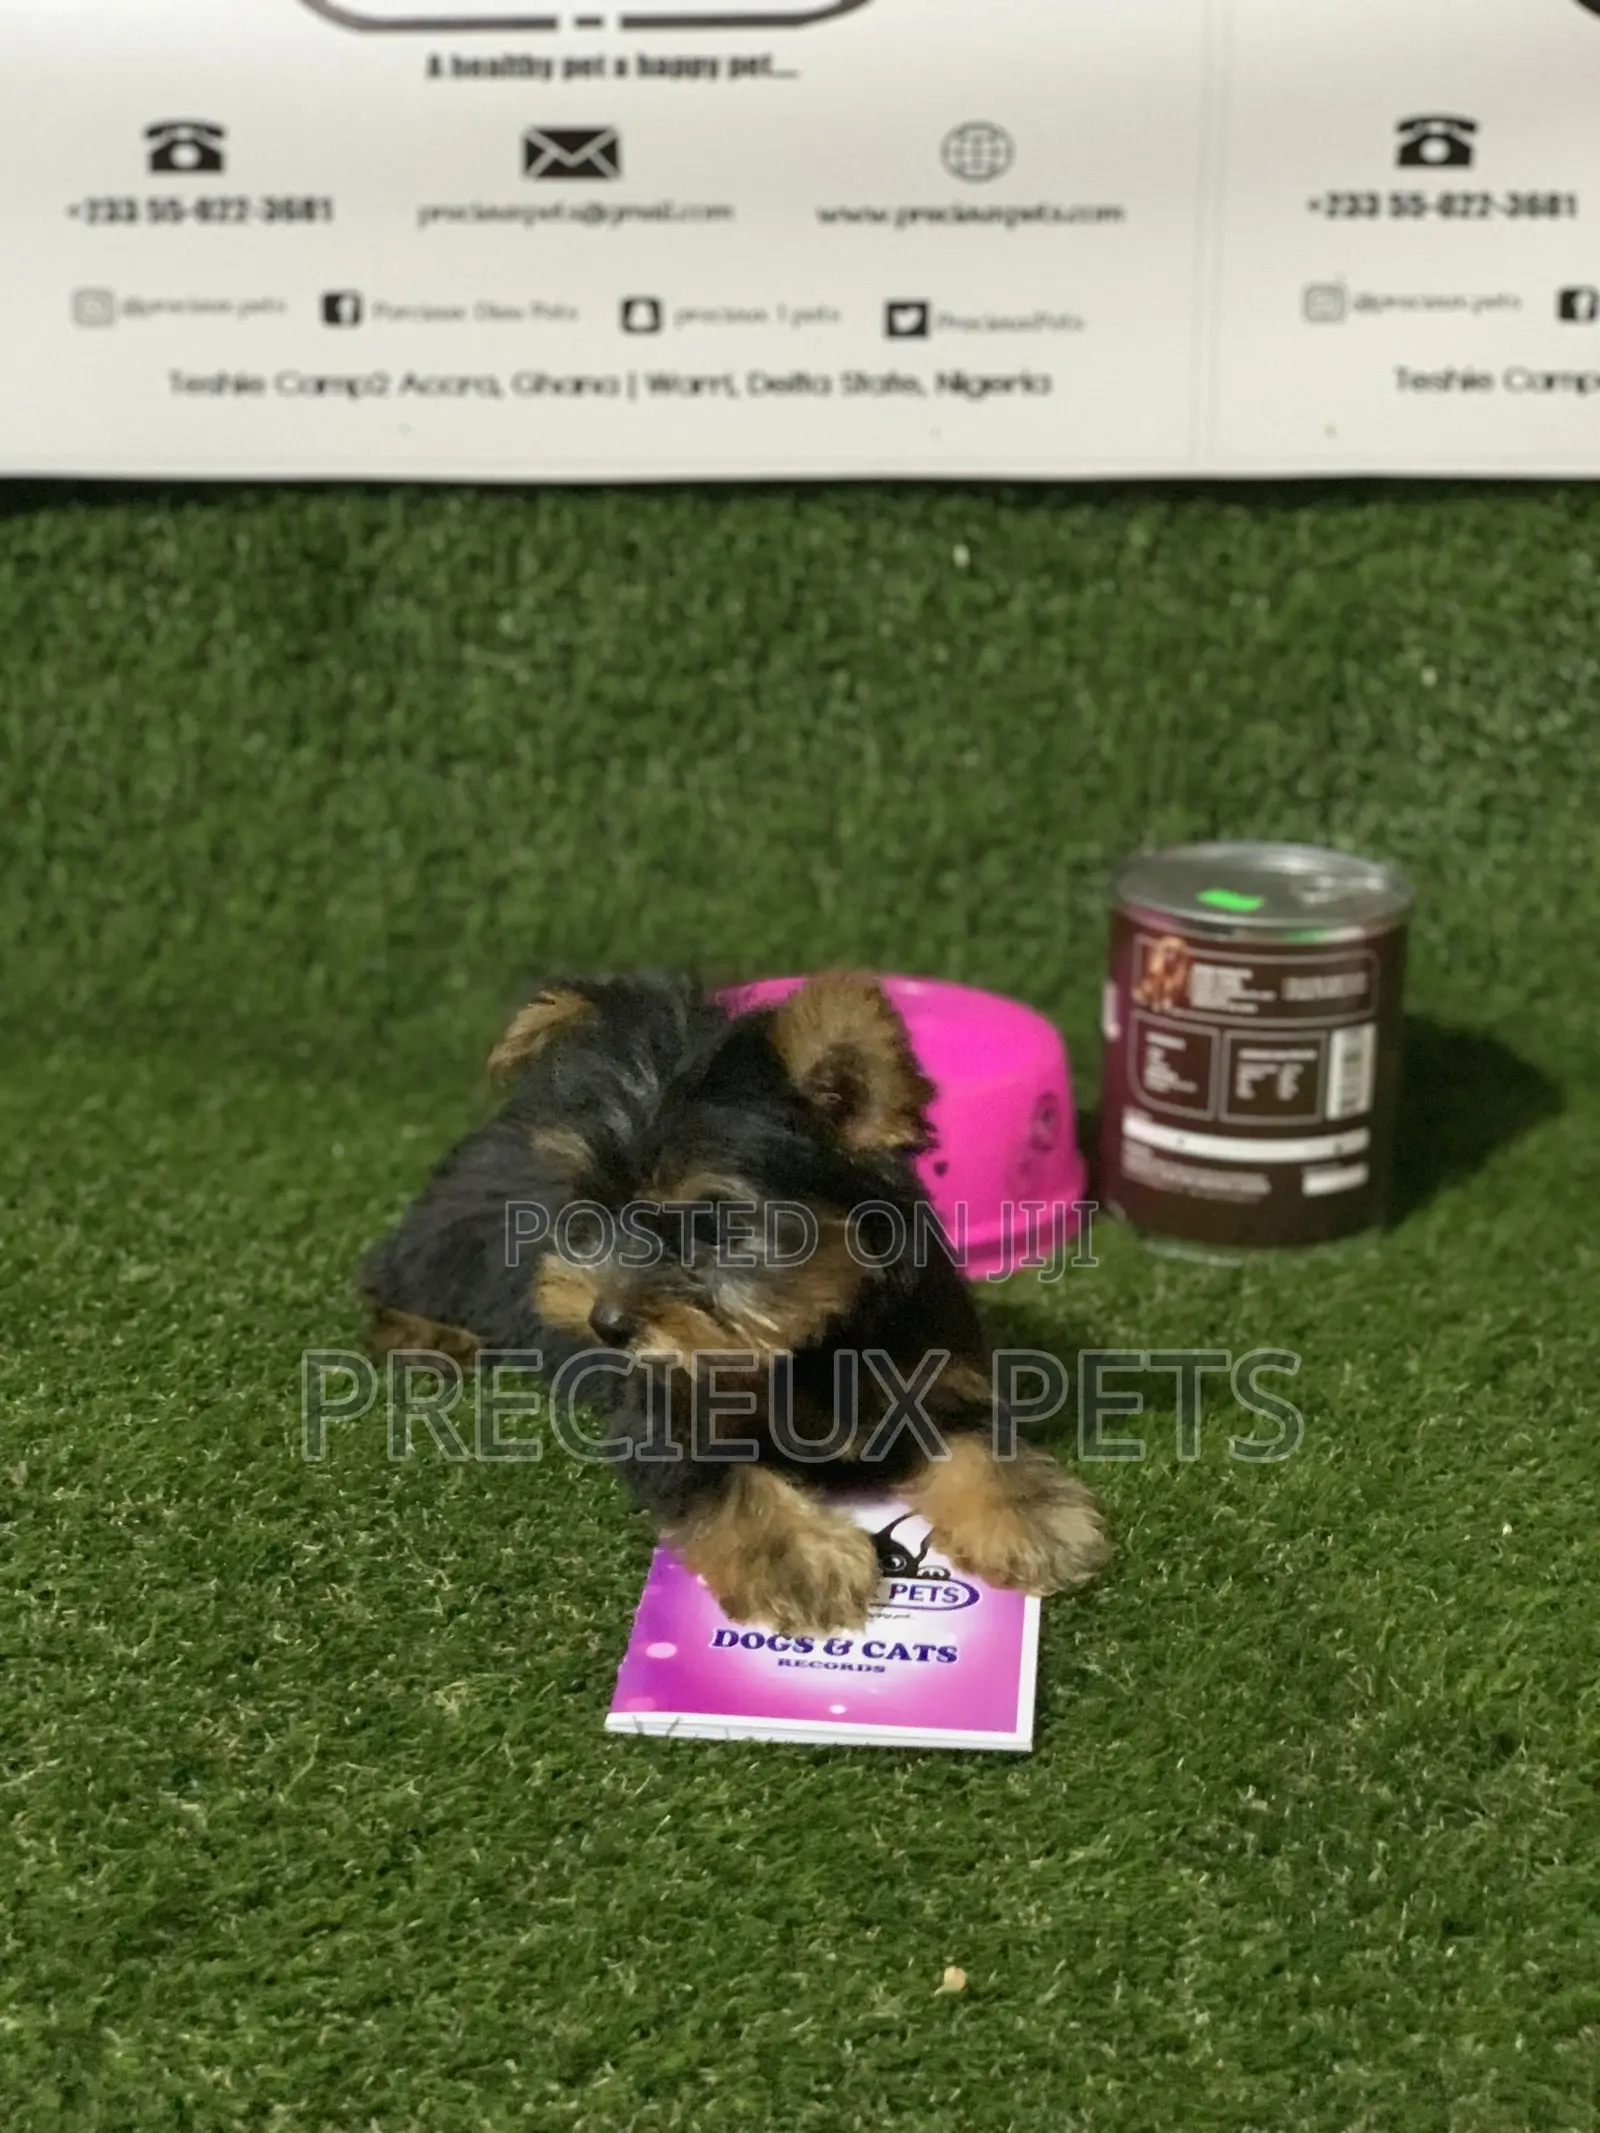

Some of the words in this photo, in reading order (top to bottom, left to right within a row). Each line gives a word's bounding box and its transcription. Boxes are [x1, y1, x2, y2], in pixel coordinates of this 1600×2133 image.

[427, 52, 442, 80] A
[451, 51, 553, 83] healthy
[561, 53, 605, 83] pet
[635, 52, 719, 83] happy
[64, 195, 138, 225] +233
[1307, 190, 1379, 220] +233
[168, 368, 267, 397] Teshie
[510, 368, 620, 399] Ghana
[643, 371, 741, 400] Warri,
[746, 370, 835, 399] Delta
[839, 370, 929, 400] State,
[934, 370, 1053, 402] Nigeria
[1393, 364, 1493, 394] Teshie
[1501, 365, 1600, 398] Camp
[888, 1582, 961, 1605] PETS
[711, 1628, 815, 1654] DOGS
[822, 1637, 854, 1657] &
[861, 1639, 959, 1664] CATS
[777, 1657, 887, 1674] RECORDS
